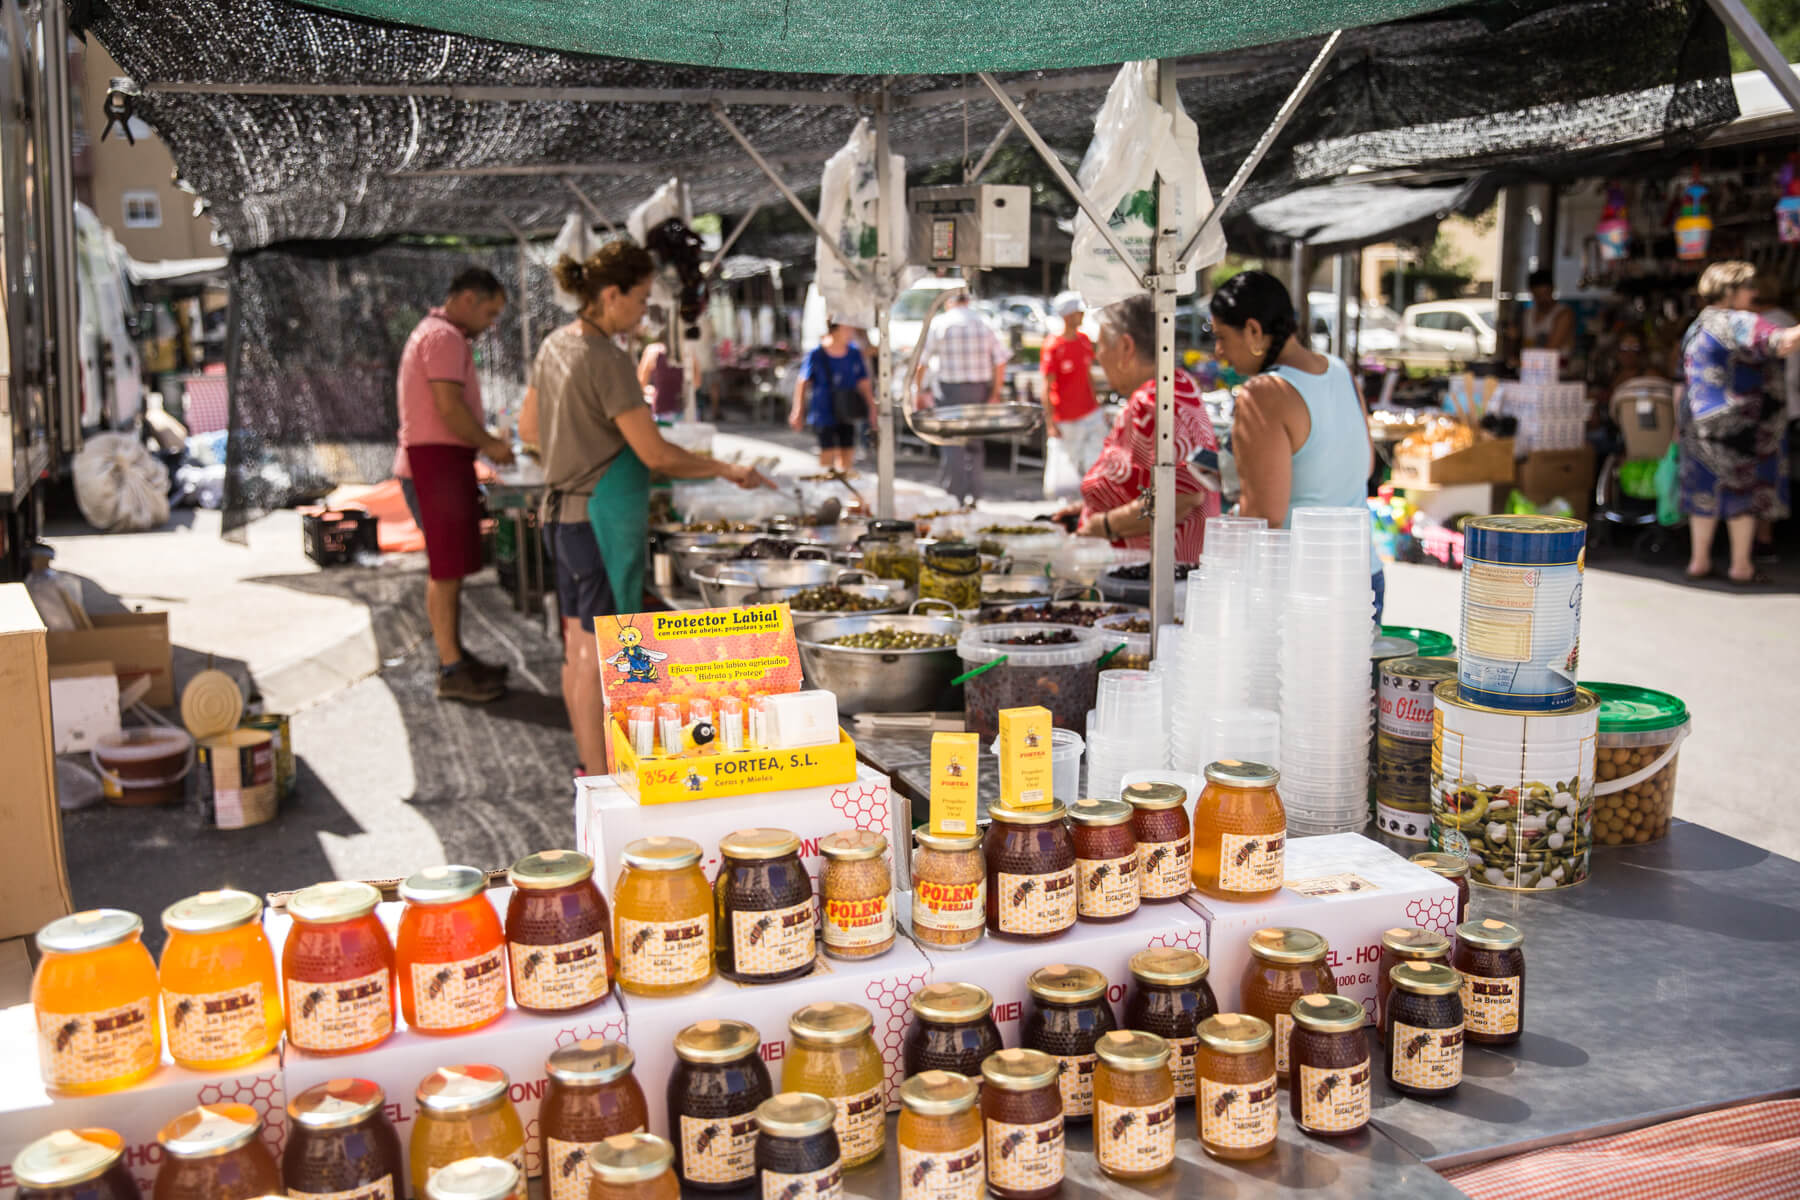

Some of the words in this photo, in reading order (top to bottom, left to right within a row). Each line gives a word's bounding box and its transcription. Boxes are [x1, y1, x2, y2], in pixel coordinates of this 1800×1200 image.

[657, 616, 726, 630] Protector
[733, 610, 778, 625] Labial
[670, 666, 693, 675] Eficaz
[694, 665, 713, 673] para
[713, 663, 724, 671] los
[725, 661, 748, 669] labios
[748, 658, 787, 668] agrietados
[734, 669, 763, 679] Protege
[714, 756, 785, 776] FORTEA,
[790, 753, 819, 768] S.L.
[747, 775, 774, 783] Mieles
[921, 883, 976, 902] POLEN
[1044, 873, 1075, 893] MEL
[830, 899, 883, 918] POLEN
[927, 900, 939, 911] DE
[941, 901, 974, 912] ABEJAS
[781, 907, 813, 930] MEL
[837, 919, 849, 928] DE
[851, 914, 884, 928] ABEJAS
[663, 923, 705, 942] MEL
[553, 942, 599, 966] MEL
[1325, 950, 1344, 967] EL
[463, 955, 502, 981] MEL
[1335, 974, 1356, 987] 1000
[1358, 971, 1373, 984] Gr.
[1471, 981, 1513, 996] MEL
[335, 980, 383, 1004] MEL
[1484, 995, 1512, 1005] Bresca
[203, 992, 256, 1016] MEL
[92, 1007, 145, 1033] MEL
[847, 1092, 882, 1116] MEL
